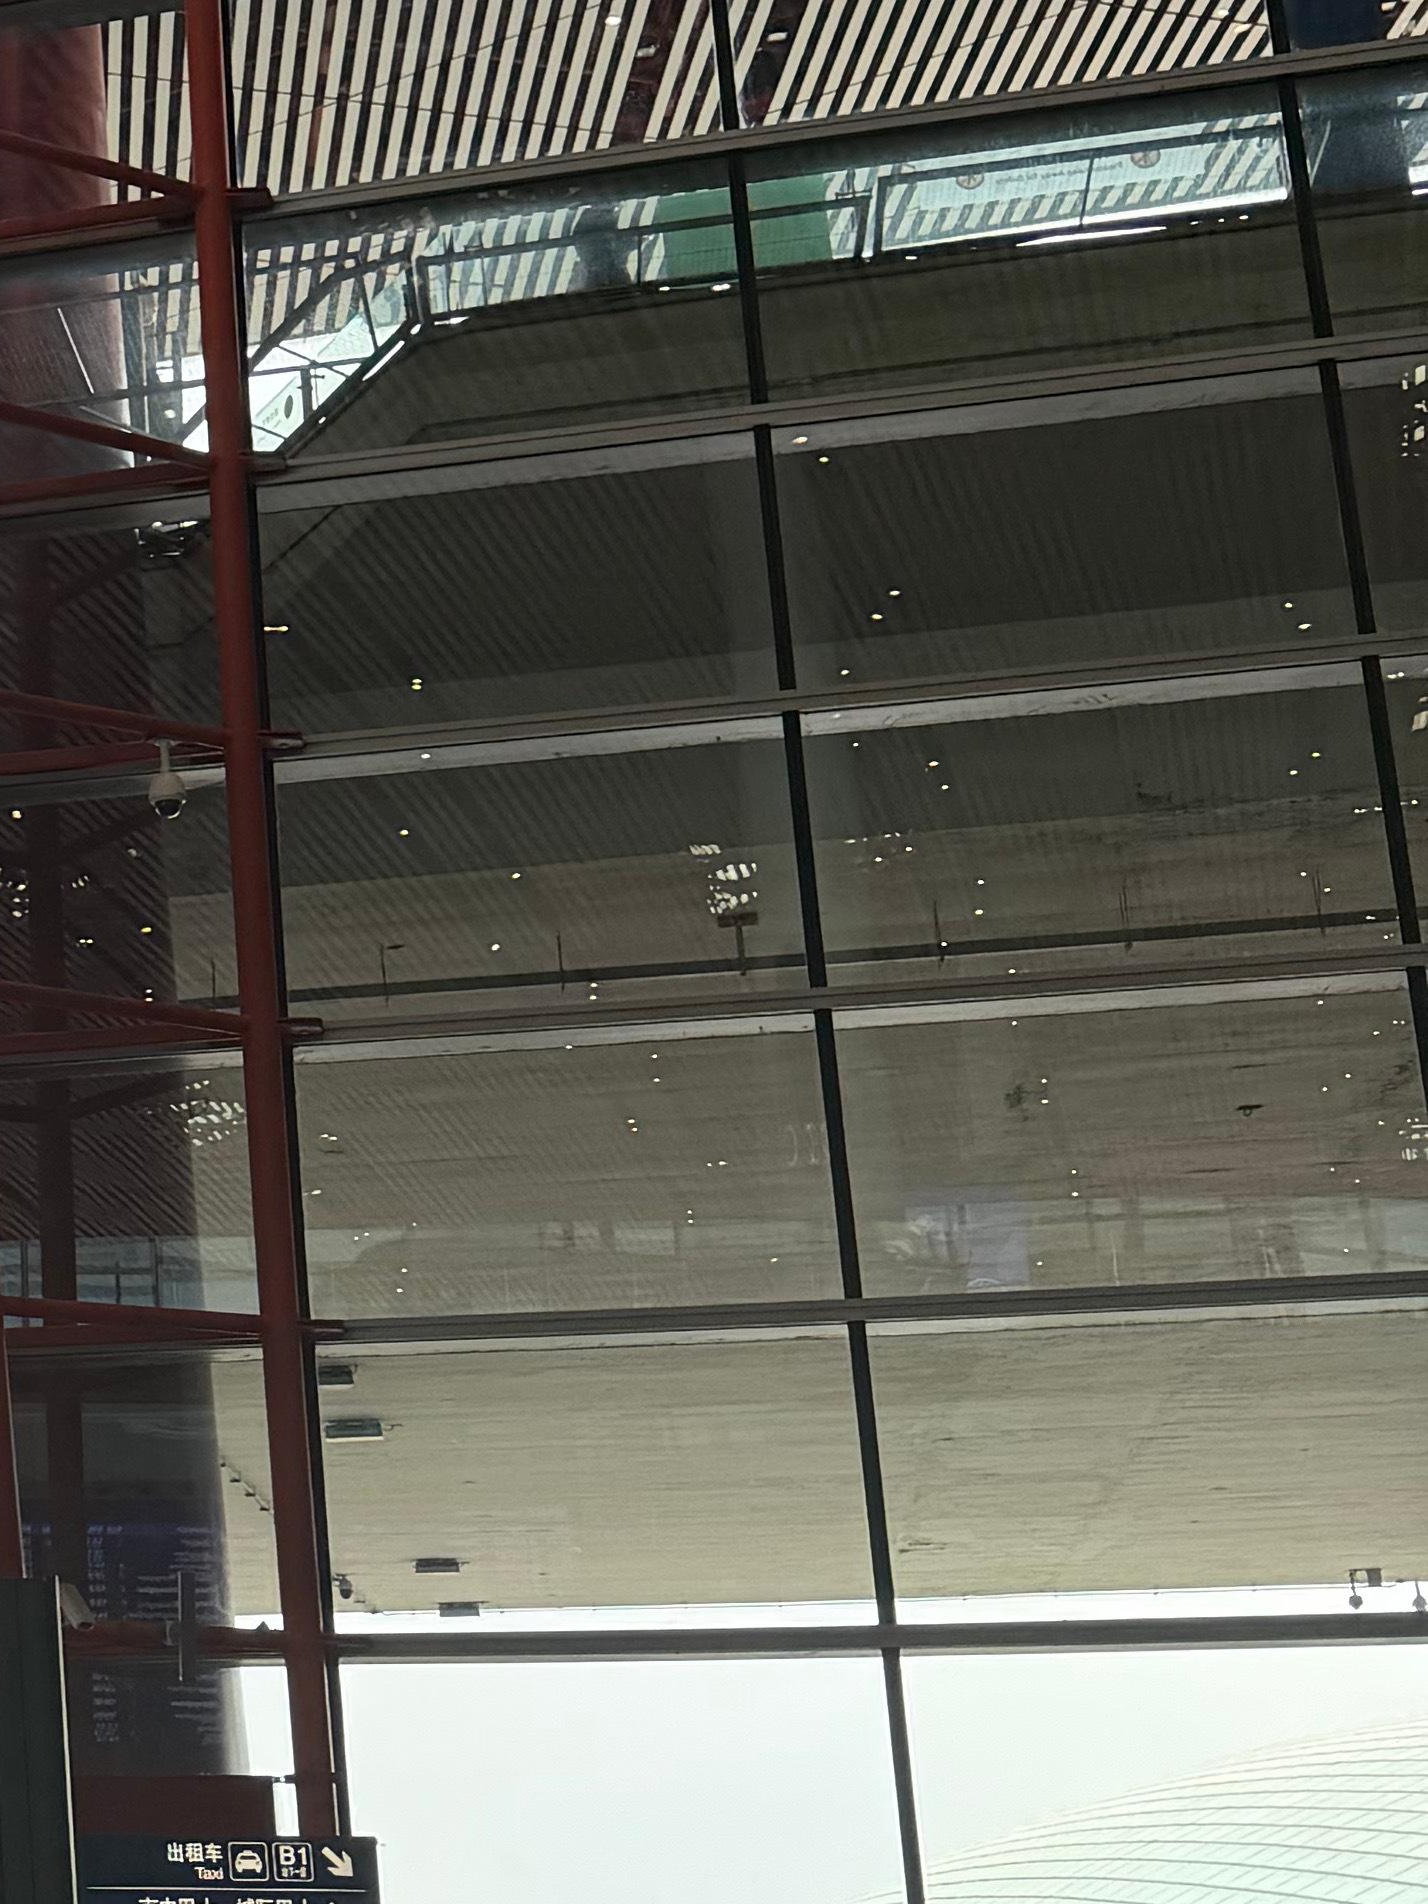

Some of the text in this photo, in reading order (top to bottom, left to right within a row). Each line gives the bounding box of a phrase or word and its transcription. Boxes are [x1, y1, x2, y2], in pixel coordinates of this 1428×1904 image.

[167, 1842, 223, 1863] 出租车
[279, 1846, 308, 1865] B1
[195, 1867, 224, 1880] Taxi
